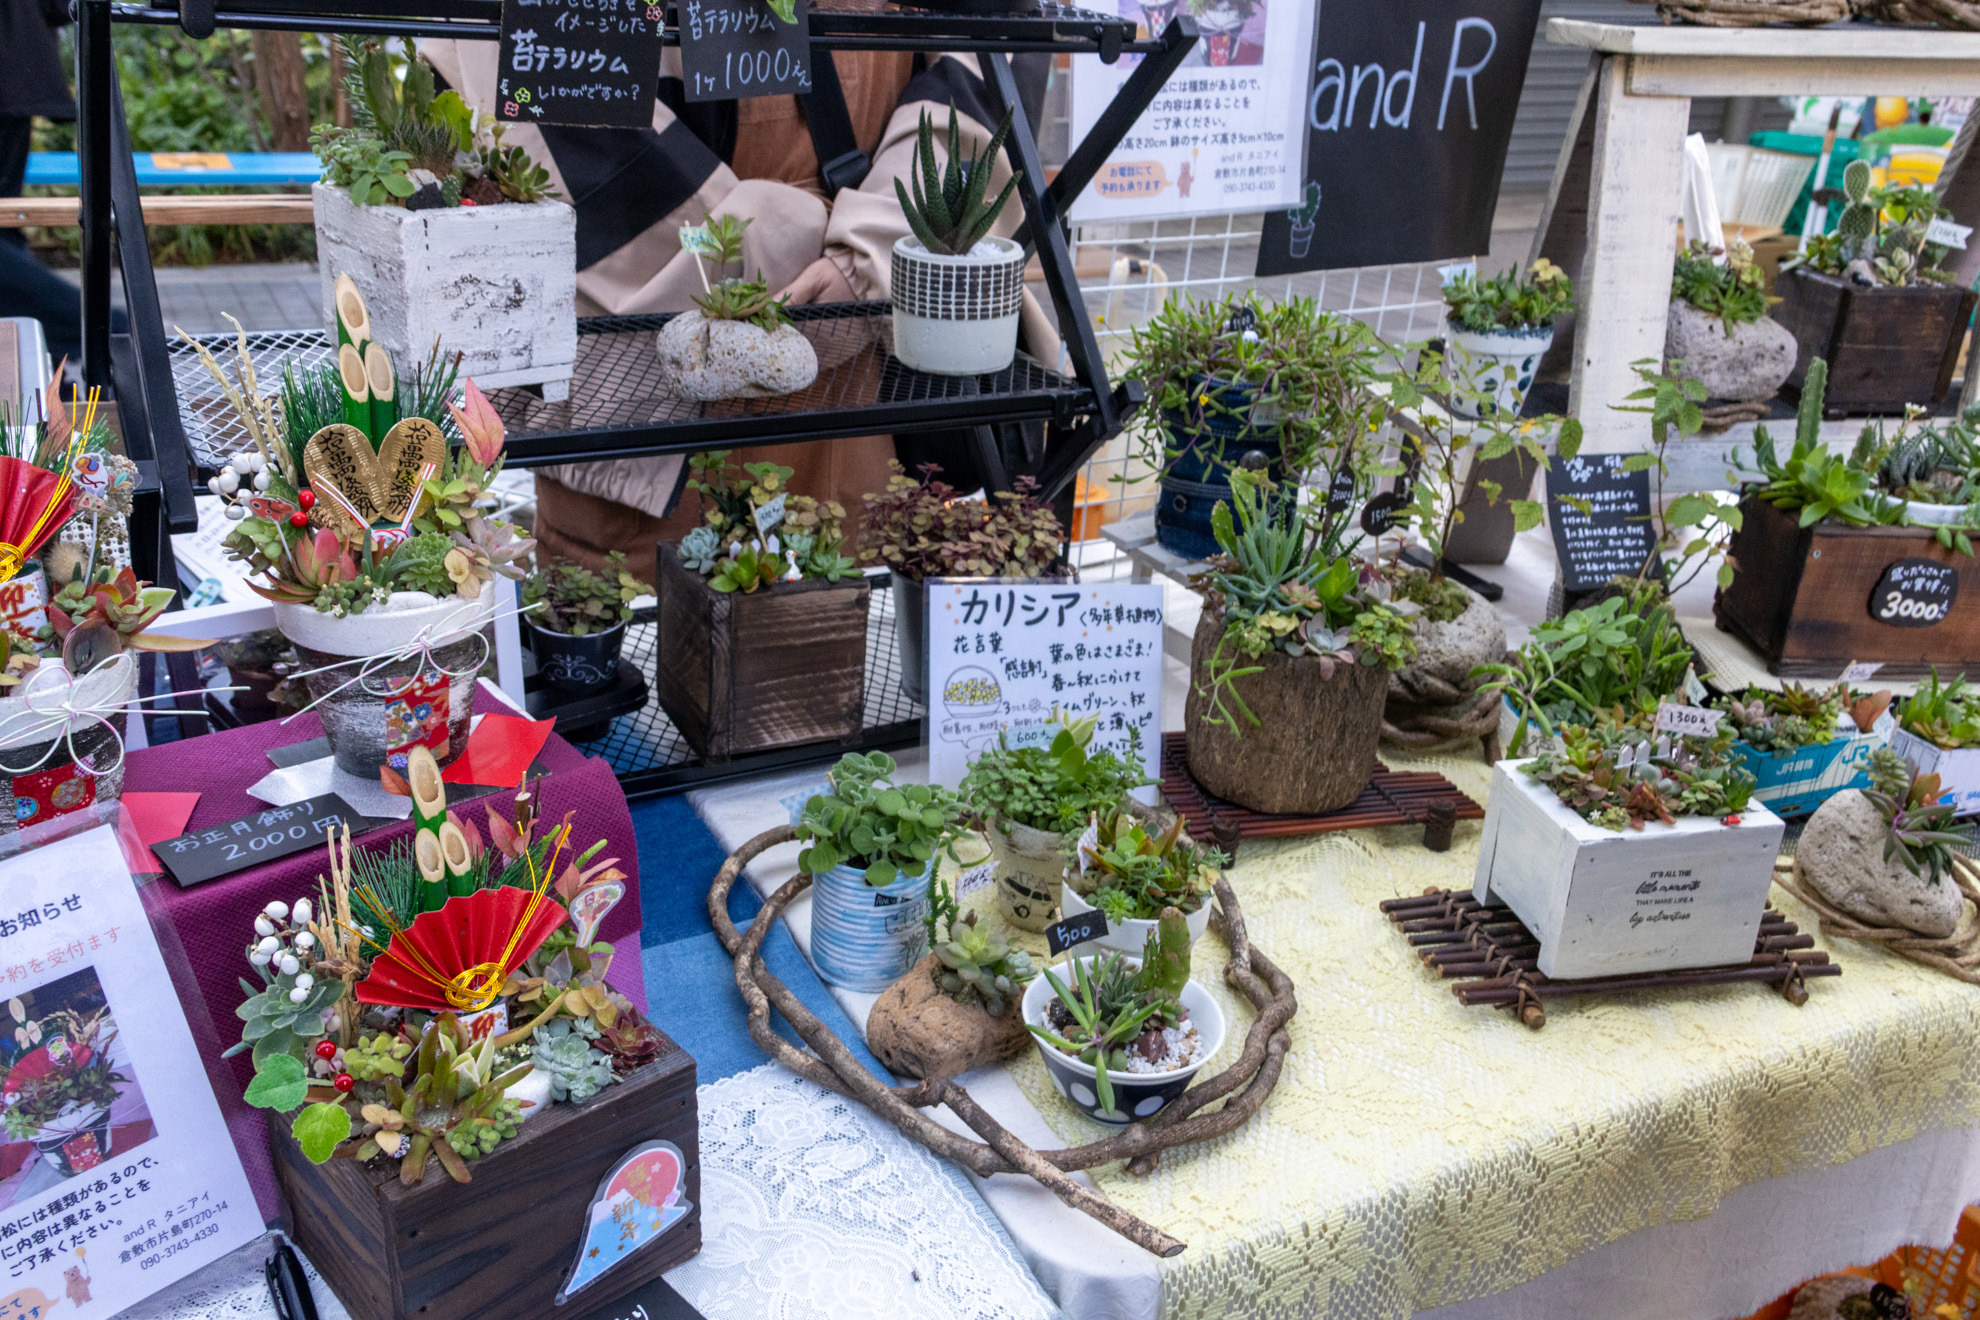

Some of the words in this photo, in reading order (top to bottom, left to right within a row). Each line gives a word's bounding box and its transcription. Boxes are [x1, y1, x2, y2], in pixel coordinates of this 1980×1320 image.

[554, 10, 647, 35] イメージした
[687, 1, 776, 41] 苔テラリウム
[510, 28, 629, 74] 苔テラリウム
[1310, 20, 1427, 132] and
[1437, 17, 1498, 131] R
[1147, 96, 1250, 112] に内容は異なることを
[1153, 117, 1227, 130] ご了承ください。
[961, 589, 1081, 627] カリシア
[954, 631, 1003, 654] 花言葉
[1093, 711, 1153, 732] と薄いピ
[168, 801, 315, 853] お正月飾り
[221, 813, 344, 862] 2000円
[1679, 869, 1692, 877] THE
[0, 893, 83, 938] お知らせ
[1057, 926, 1091, 948] 500
[0, 1156, 160, 1242] 松には種類があるので、
[0, 1179, 151, 1260] に内容は異なることを
[123, 1224, 145, 1243] and
[147, 1218, 158, 1231] R
[165, 1190, 210, 1223] タニアイ
[9, 1219, 123, 1278] ご了承ください。
[118, 1200, 229, 1265] 倉敷市片島町270-14
[140, 1222, 220, 1271] 090-3743-4330
